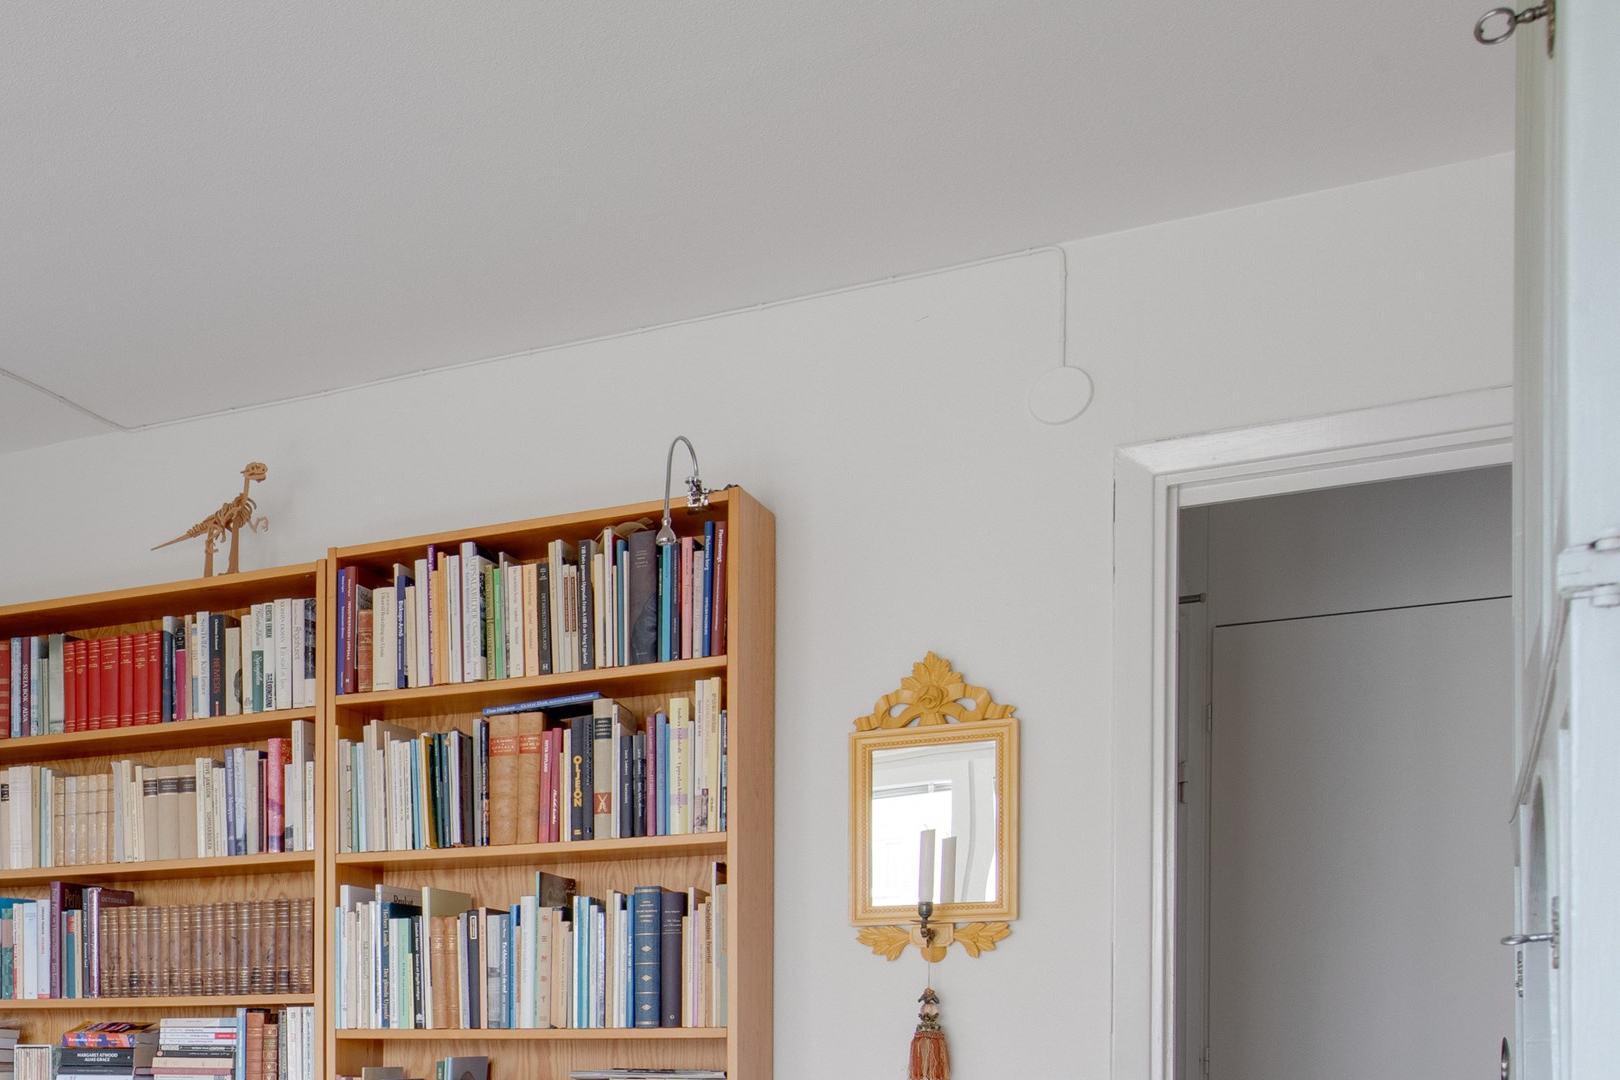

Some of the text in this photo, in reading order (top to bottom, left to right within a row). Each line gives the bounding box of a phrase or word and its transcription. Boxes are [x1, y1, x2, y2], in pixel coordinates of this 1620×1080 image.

[265, 605, 273, 622] KERSTIN
[265, 623, 273, 639] EKMAN
[213, 658, 221, 694] NEMESIS
